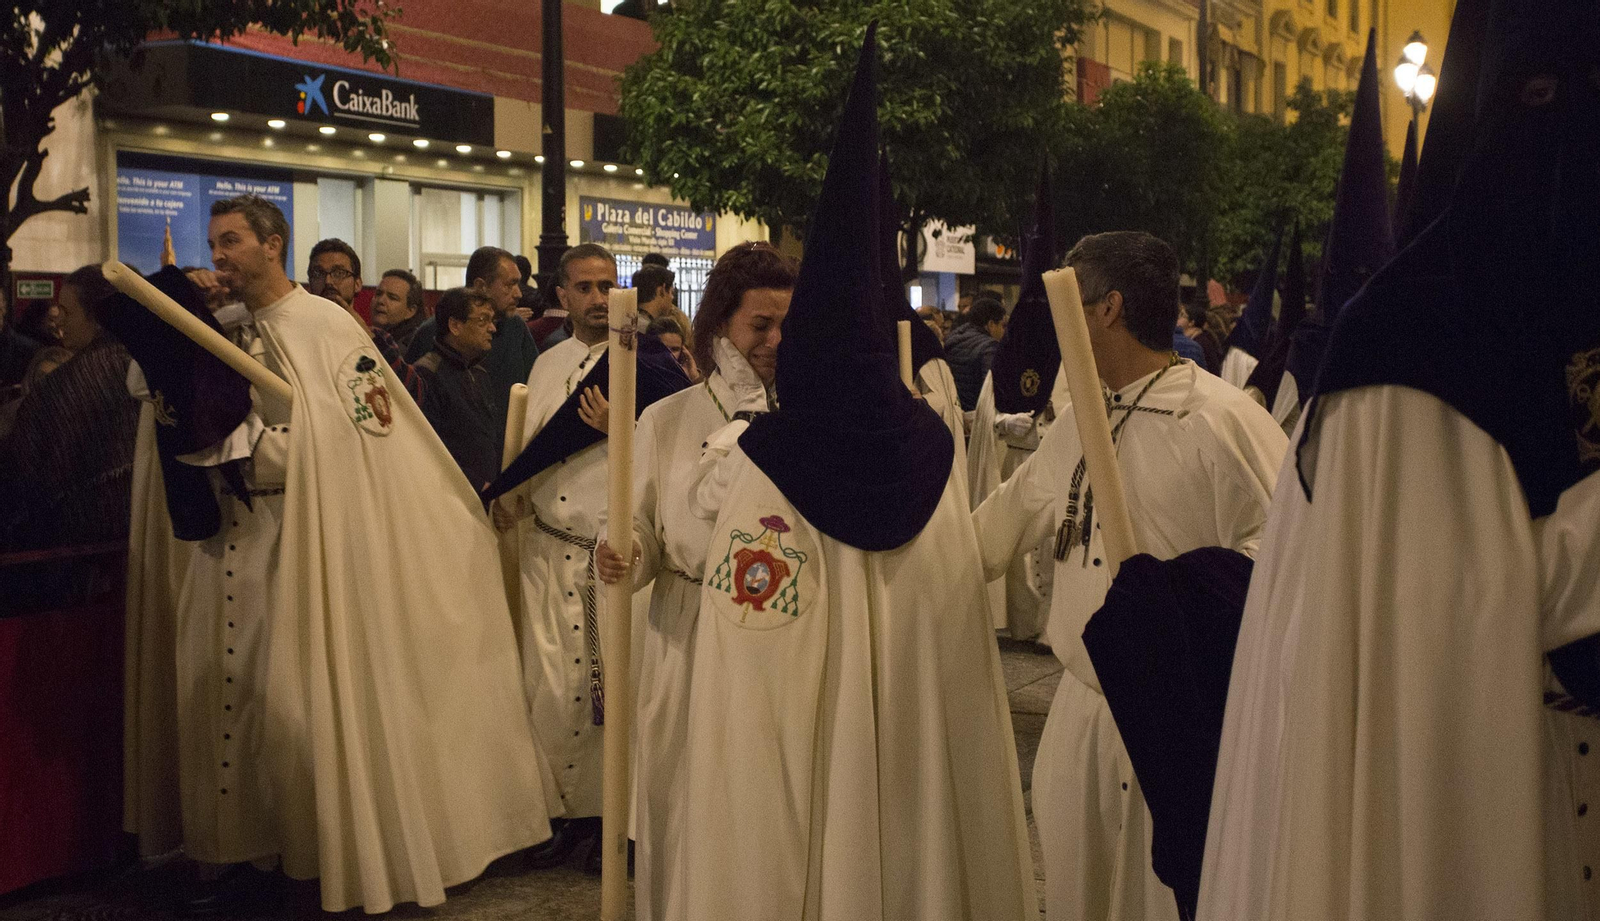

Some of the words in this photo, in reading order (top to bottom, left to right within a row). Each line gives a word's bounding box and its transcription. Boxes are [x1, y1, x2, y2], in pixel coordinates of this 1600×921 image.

[333, 80, 420, 120] CaixaBank
[132, 176, 146, 186] This
[153, 180, 169, 189] your
[169, 180, 184, 189] ATM
[234, 182, 247, 191] This
[253, 185, 267, 194] your
[267, 185, 280, 194] ATM
[597, 202, 631, 223] Plaza
[635, 207, 654, 226] del
[658, 208, 703, 230] Cabildo
